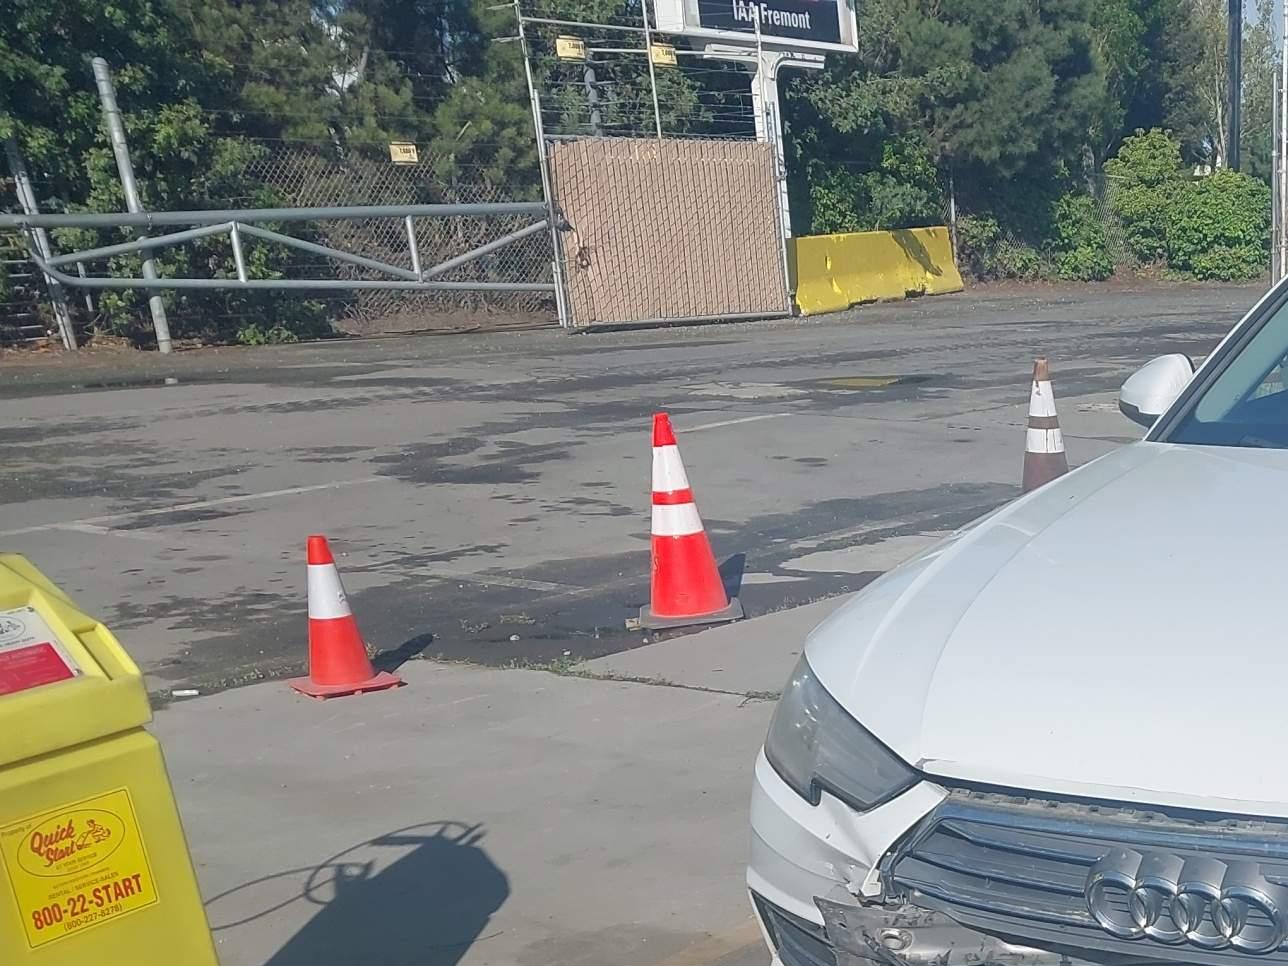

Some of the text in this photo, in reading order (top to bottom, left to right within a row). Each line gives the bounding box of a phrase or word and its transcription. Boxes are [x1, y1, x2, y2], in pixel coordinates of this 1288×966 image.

[759, 3, 812, 30] Fremont
[30, 818, 76, 857] Quick
[43, 840, 77, 868] Start
[32, 873, 143, 930] 800-22-START
